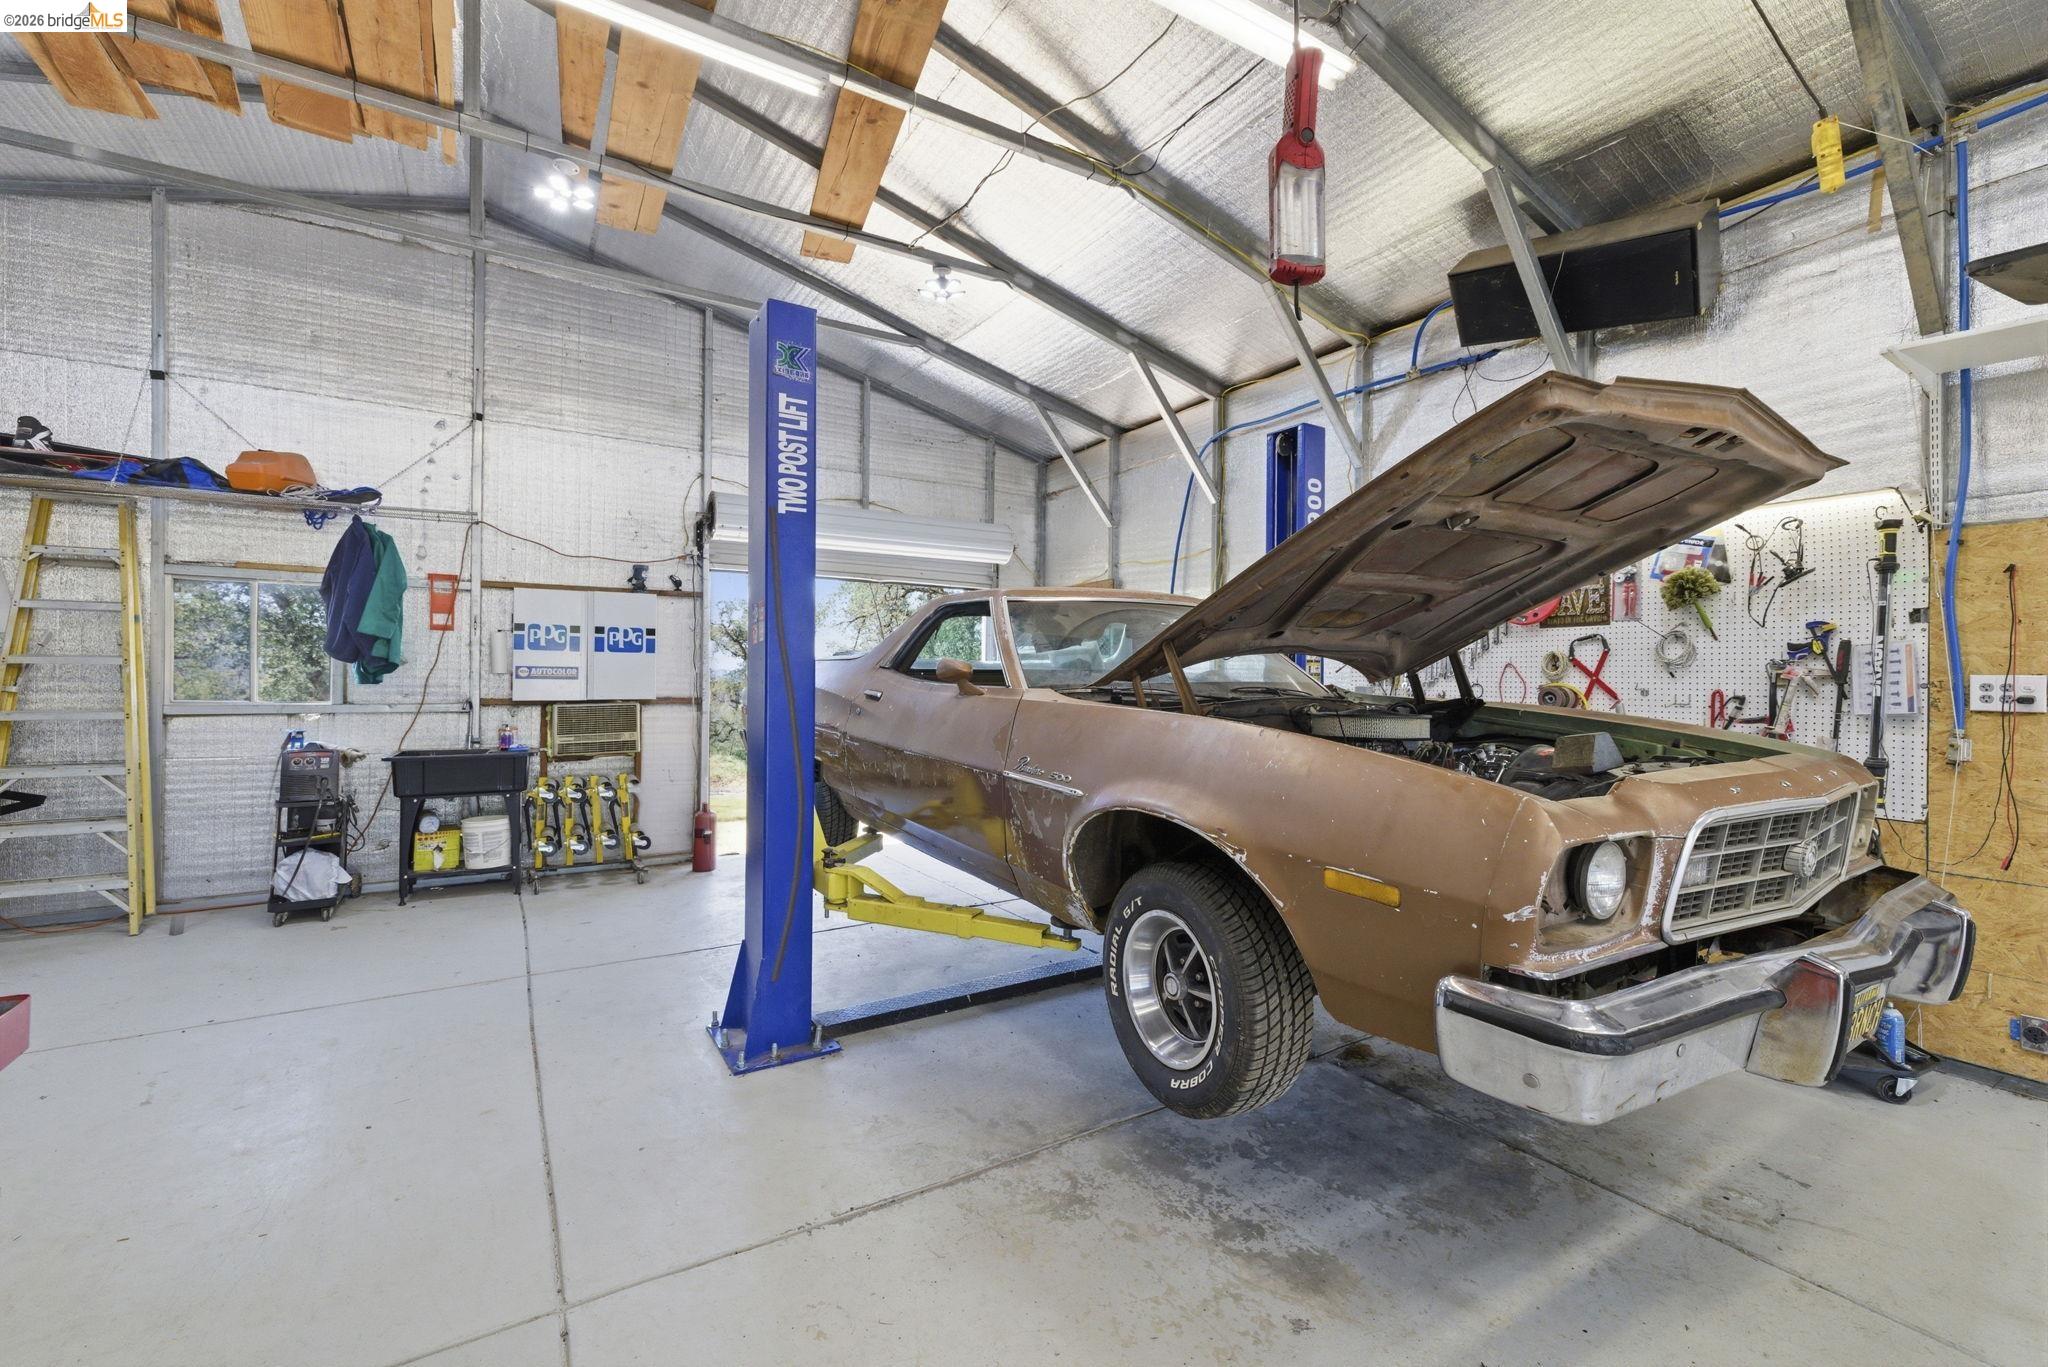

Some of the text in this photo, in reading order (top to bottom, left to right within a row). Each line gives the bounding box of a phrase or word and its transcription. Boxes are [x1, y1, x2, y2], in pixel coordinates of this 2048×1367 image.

[778, 392, 808, 431] LIFT
[777, 431, 808, 477] POST
[777, 479, 807, 514] TWO
[1551, 584, 1606, 616] AVE
[529, 624, 566, 647] PPG
[608, 627, 643, 649] PPG
[531, 667, 578, 677] AUTOCOLOR
[1122, 896, 1143, 920] G/T
[1110, 924, 1124, 997] RADIAL
[1170, 1060, 1214, 1090] COBRA
